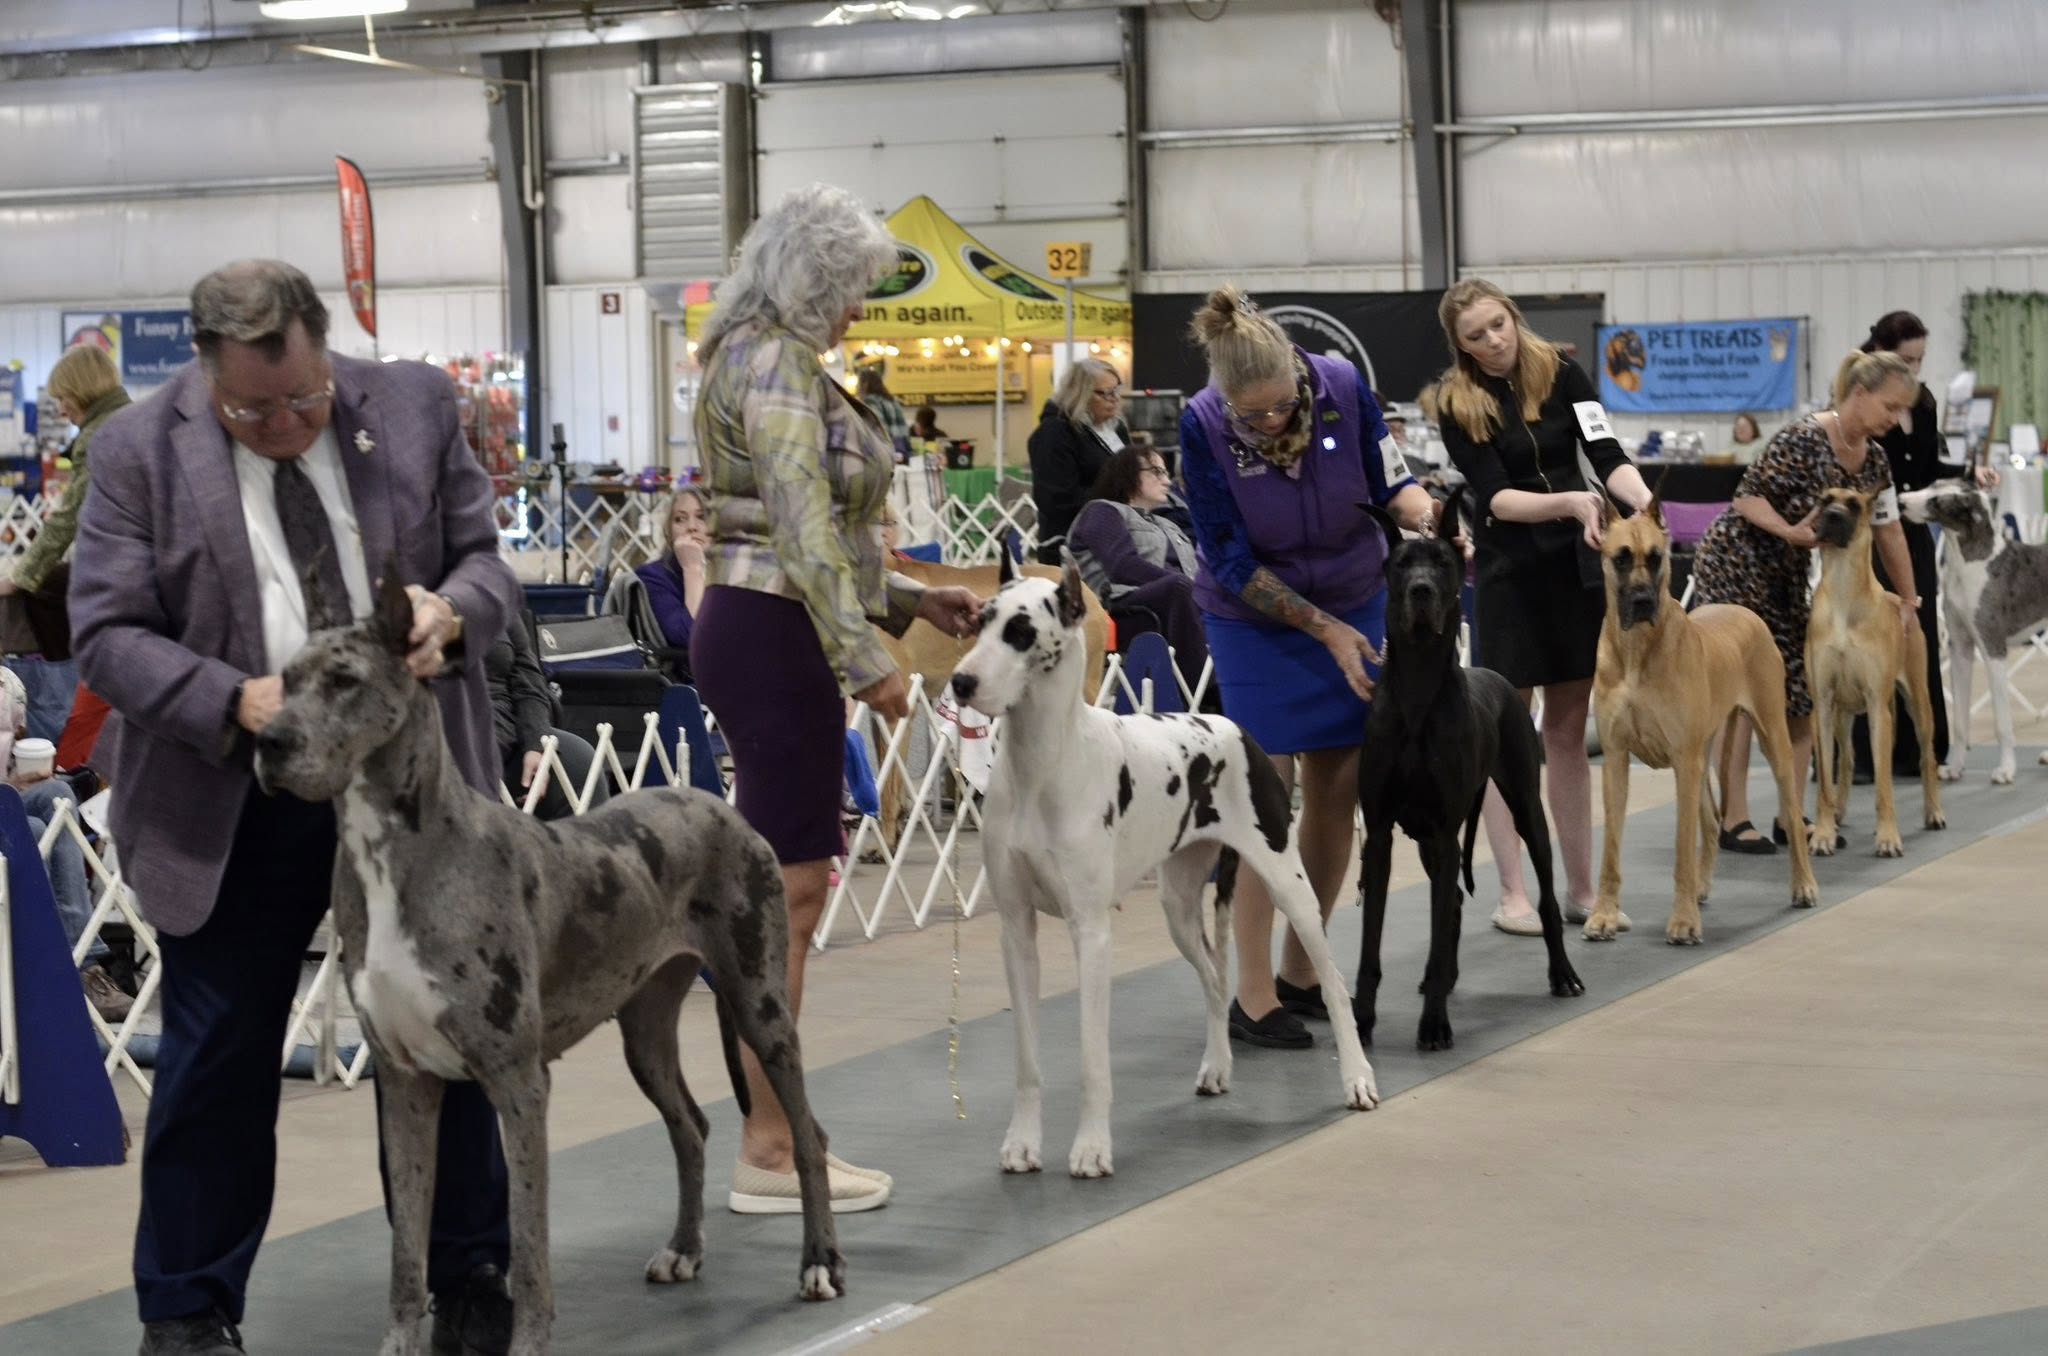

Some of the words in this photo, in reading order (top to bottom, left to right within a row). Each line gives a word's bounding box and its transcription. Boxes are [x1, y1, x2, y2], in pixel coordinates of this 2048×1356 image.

[1048, 248, 1078, 271] 32
[897, 304, 973, 325] again.
[135, 316, 180, 341] Funny
[1648, 329, 1686, 349] PET
[1690, 327, 1763, 349] TREATS
